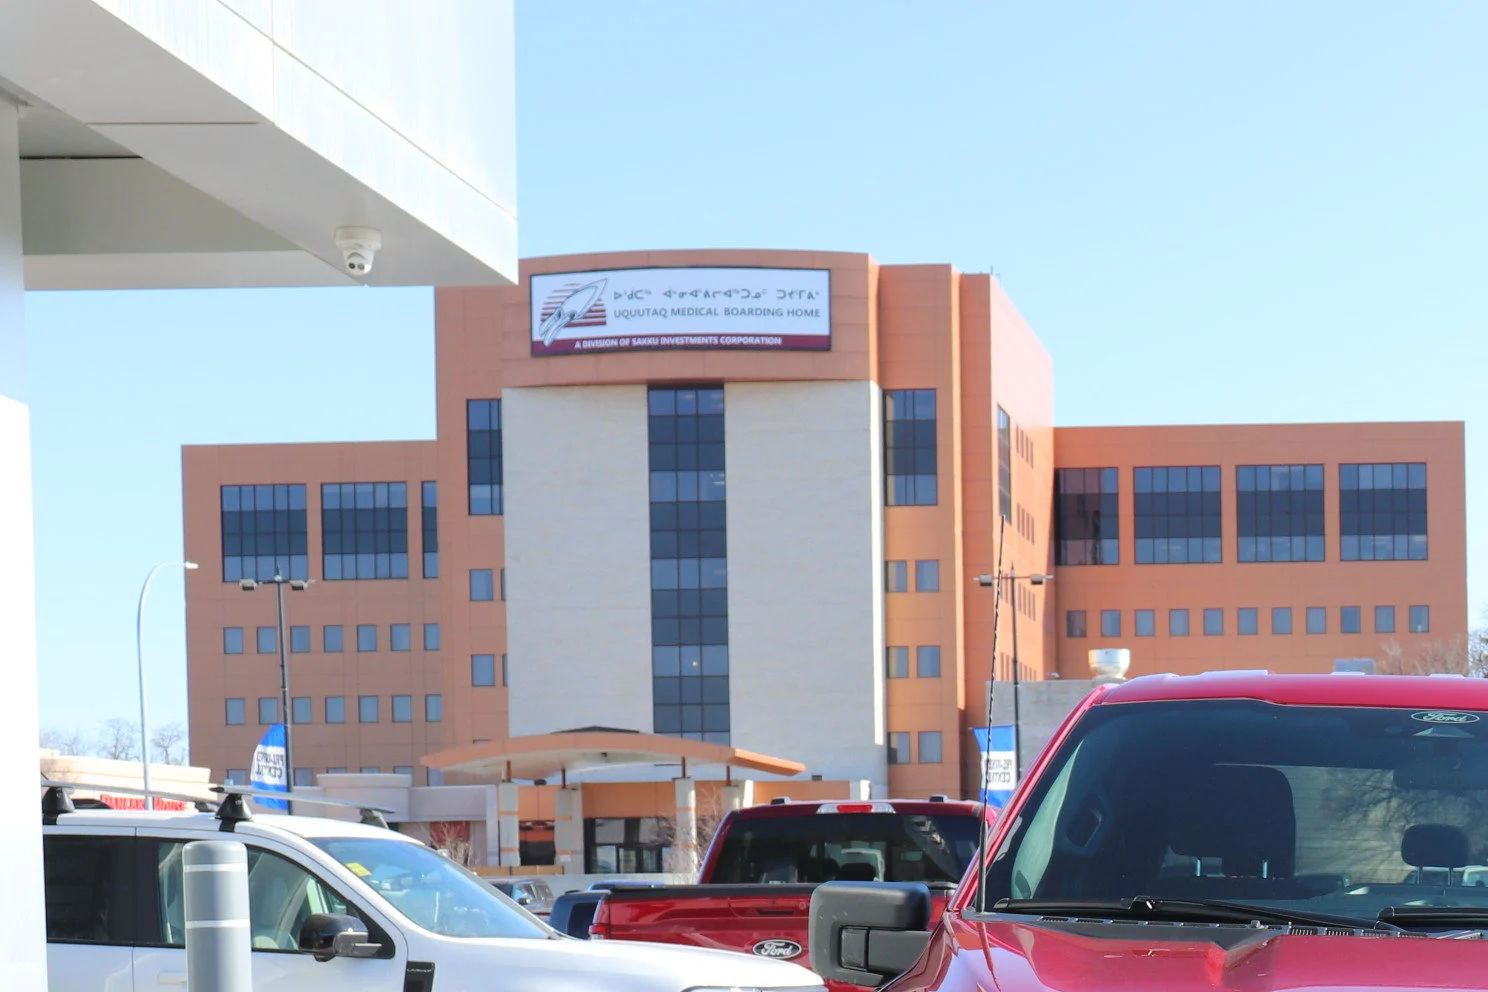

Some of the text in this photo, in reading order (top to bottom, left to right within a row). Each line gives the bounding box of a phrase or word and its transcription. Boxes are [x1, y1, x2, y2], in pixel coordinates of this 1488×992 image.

[613, 306, 821, 319] UQUUTAQ MEDICAL BOARDING HOME
[574, 341, 582, 350] A
[583, 339, 618, 348] DIVISION
[619, 338, 630, 347] OF
[660, 335, 718, 345] INVESTMENTS
[720, 335, 782, 345] CORPORATION
[1421, 711, 1467, 724] Ford
[761, 942, 793, 956] Ford
